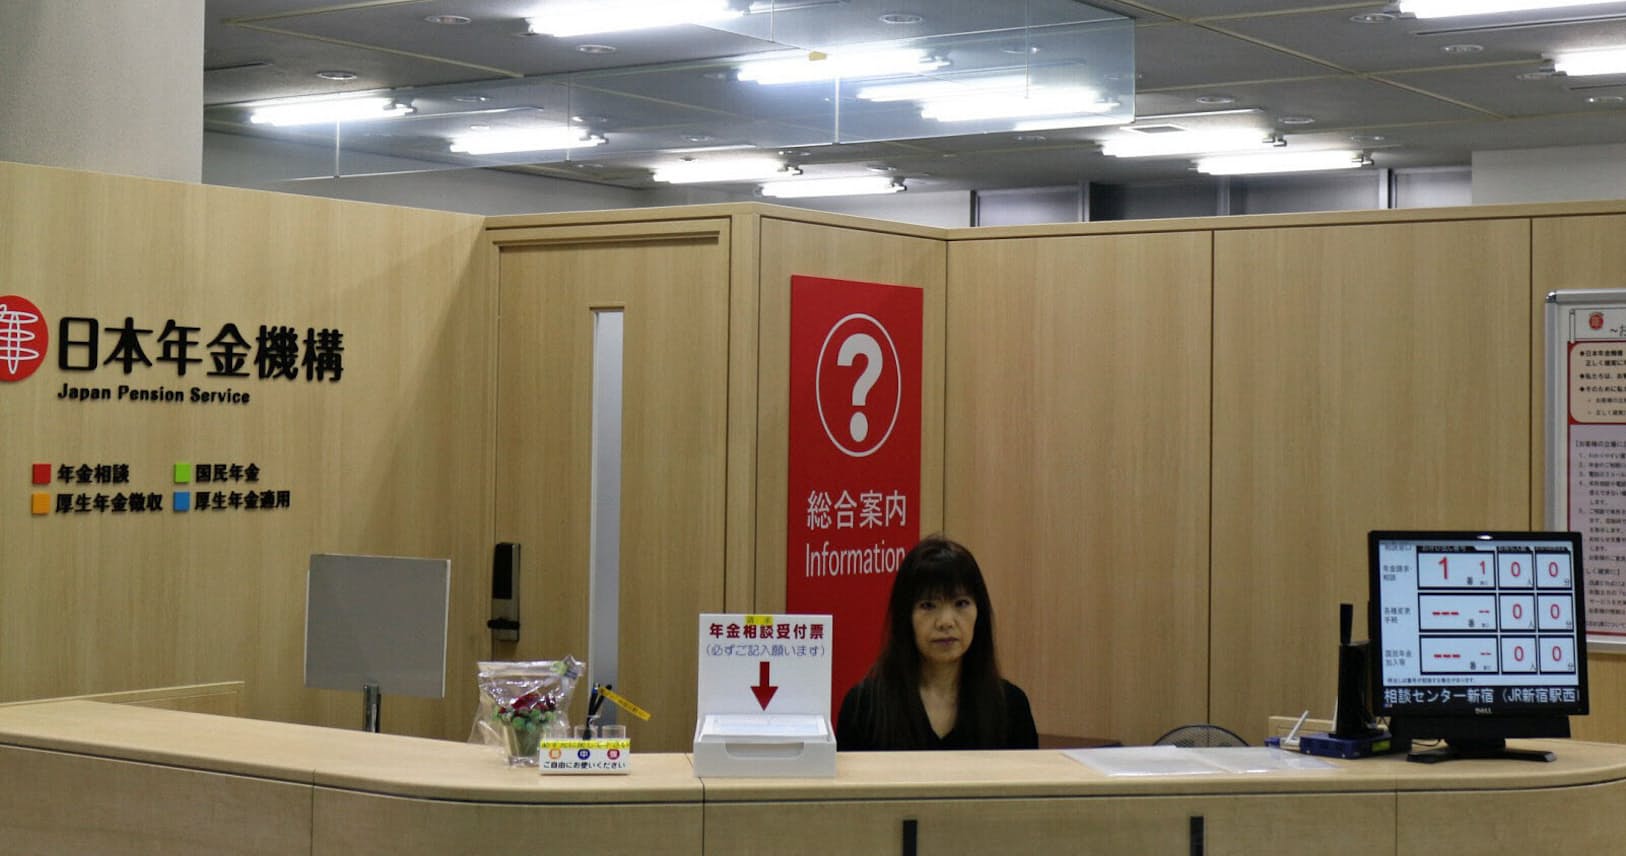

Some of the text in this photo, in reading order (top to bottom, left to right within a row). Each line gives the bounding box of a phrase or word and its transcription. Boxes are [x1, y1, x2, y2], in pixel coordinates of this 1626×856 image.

[58, 316, 345, 382] 日本年金機構
[58, 383, 250, 405] Japan Pension Service
[57, 463, 130, 484] 年金相談
[195, 463, 260, 483] 国民年金
[56, 491, 163, 513] 厚生年金徴収
[194, 490, 291, 511] 厚生年金適用
[806, 489, 907, 530] 総合案内
[805, 540, 906, 578] Information
[1438, 556, 1449, 580] 1
[1480, 561, 1486, 575] 1
[1510, 561, 1521, 578] 0
[1549, 561, 1559, 578] 0
[1512, 604, 1522, 619] 0
[1550, 604, 1560, 619] 0
[709, 623, 825, 640] 年金相談受付票
[1514, 646, 1524, 662] 0
[1552, 646, 1562, 662] 0
[1384, 688, 1580, 705] 相談センター新宿（JR新宿駅西
[543, 761, 626, 769] ご自由にお使いください
